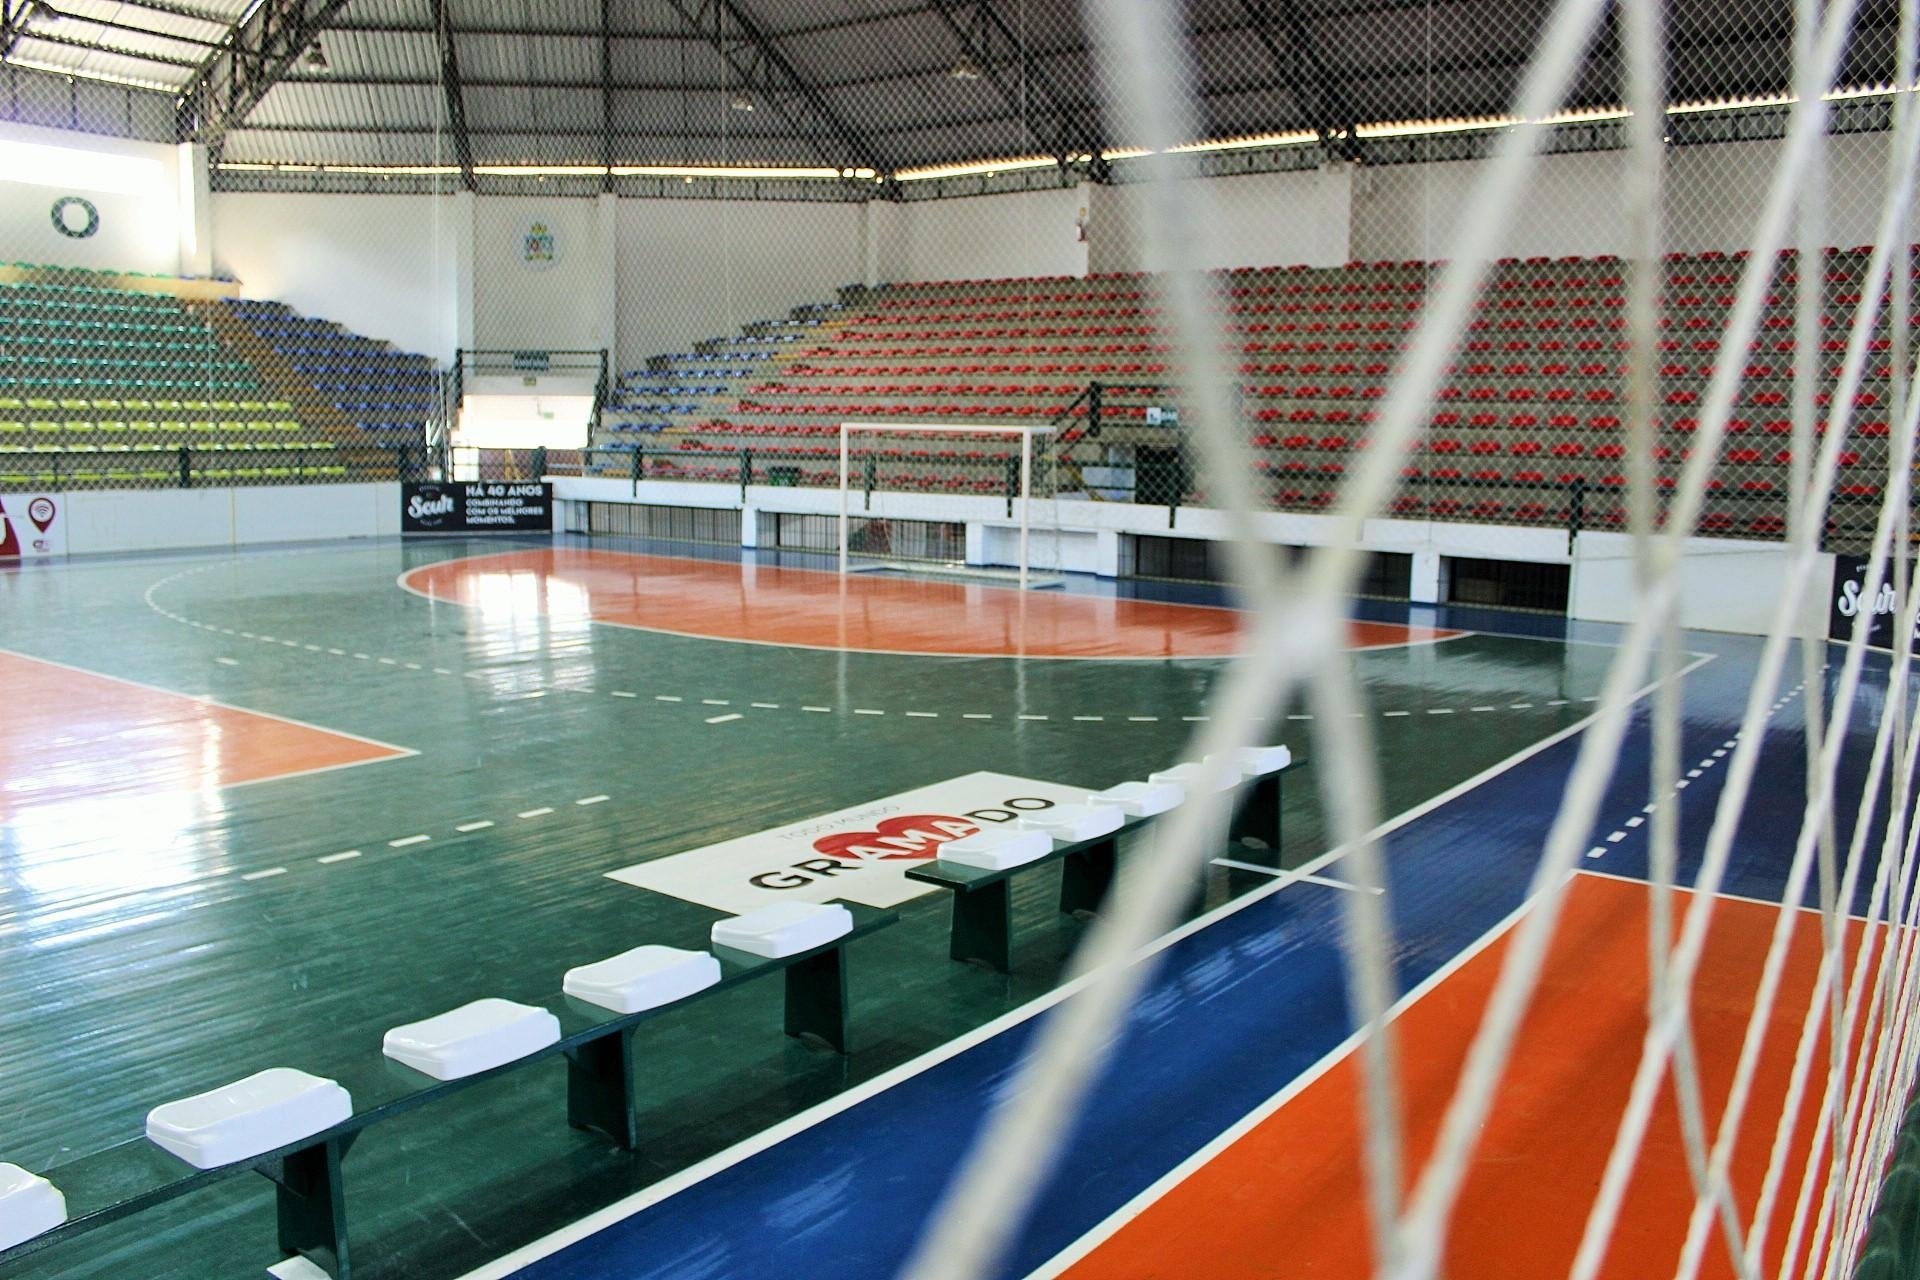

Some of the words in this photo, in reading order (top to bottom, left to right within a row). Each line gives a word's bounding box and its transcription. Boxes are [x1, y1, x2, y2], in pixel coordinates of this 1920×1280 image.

[487, 485, 505, 497] 40
[507, 485, 543, 497] ANOS
[466, 498, 523, 507] COMBINANDO
[466, 507, 486, 516] COM
[487, 507, 499, 516] OS
[500, 507, 543, 516] MELHORES
[749, 797, 1055, 890] GRAMADO
